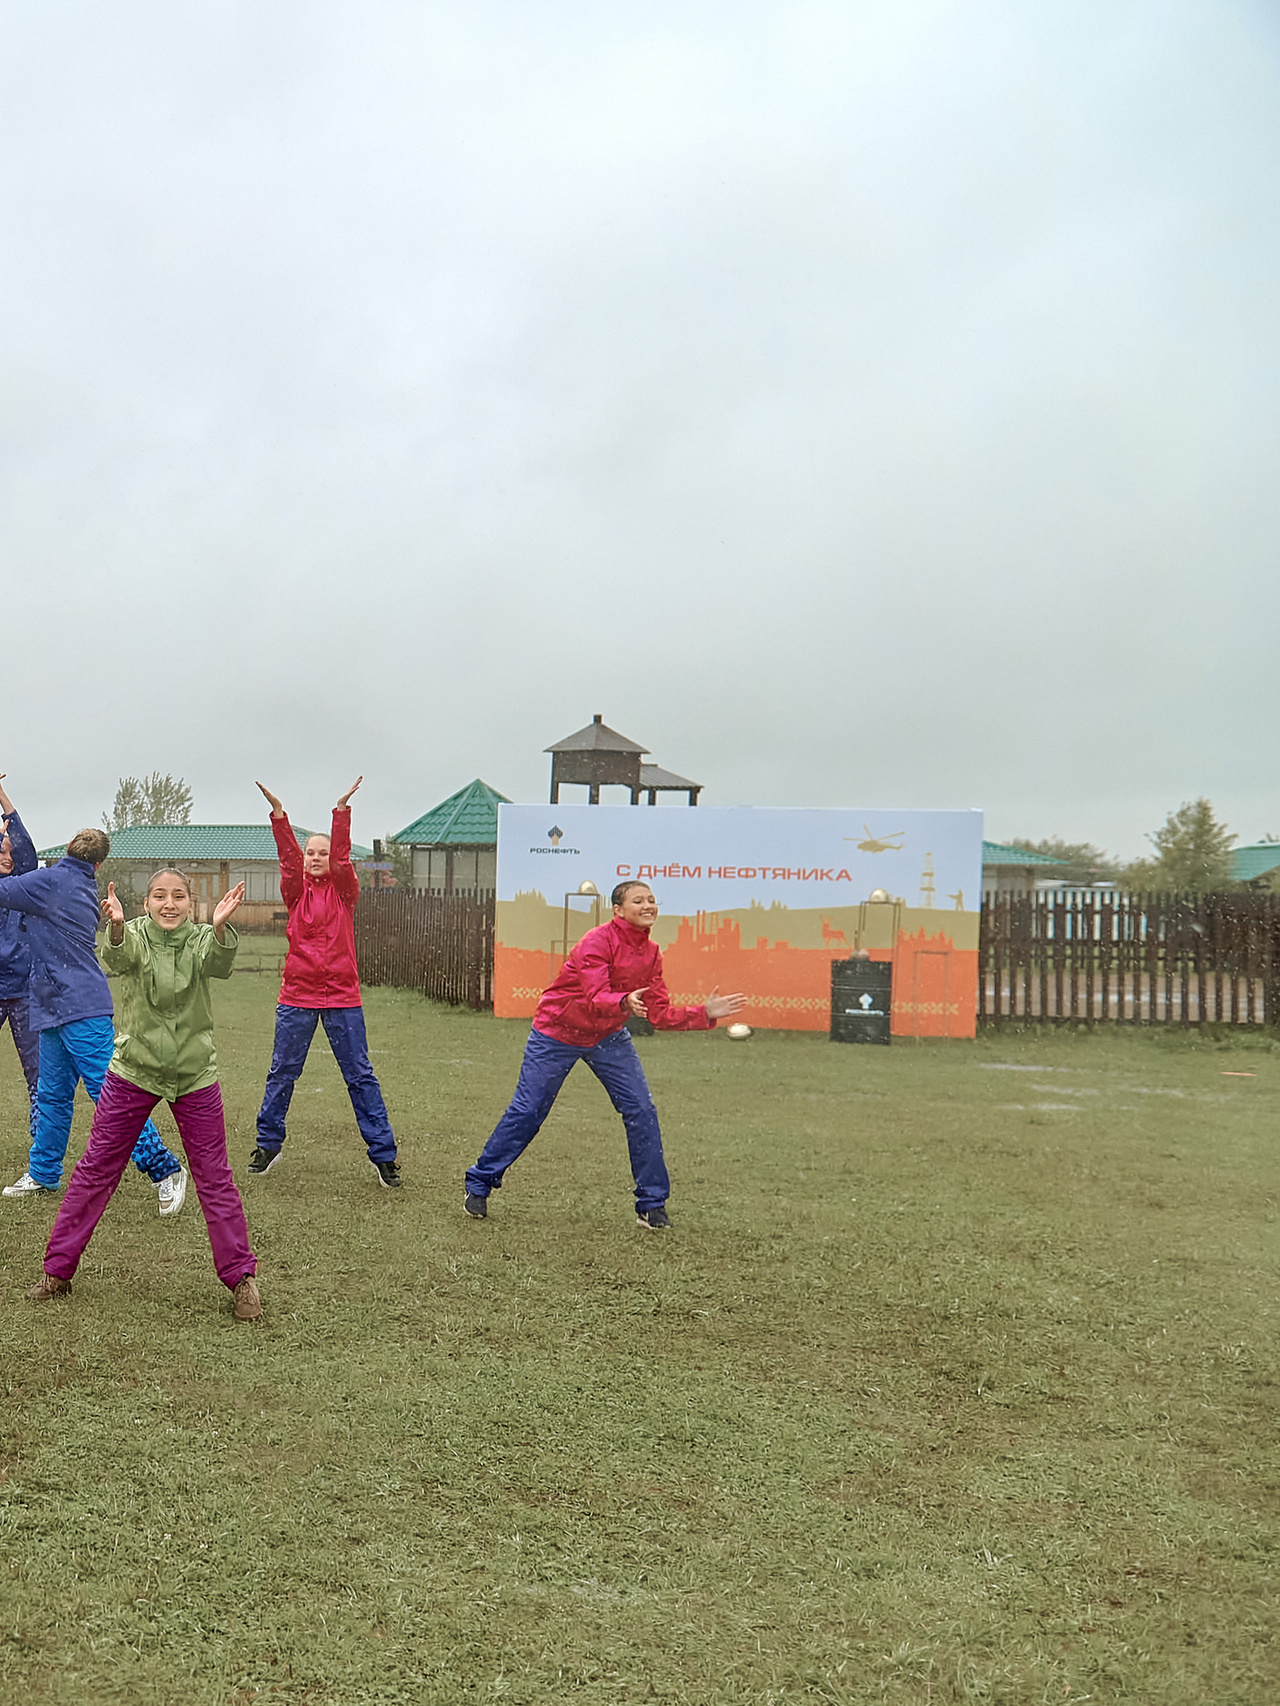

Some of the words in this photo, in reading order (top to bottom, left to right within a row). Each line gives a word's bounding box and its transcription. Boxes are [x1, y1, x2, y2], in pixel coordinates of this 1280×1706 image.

[529, 847, 581, 855] РОСНЕФТЬ
[616, 864, 632, 877] С
[637, 862, 702, 880] ДНЁМ
[708, 866, 853, 882] НЕФТЯНИКА
